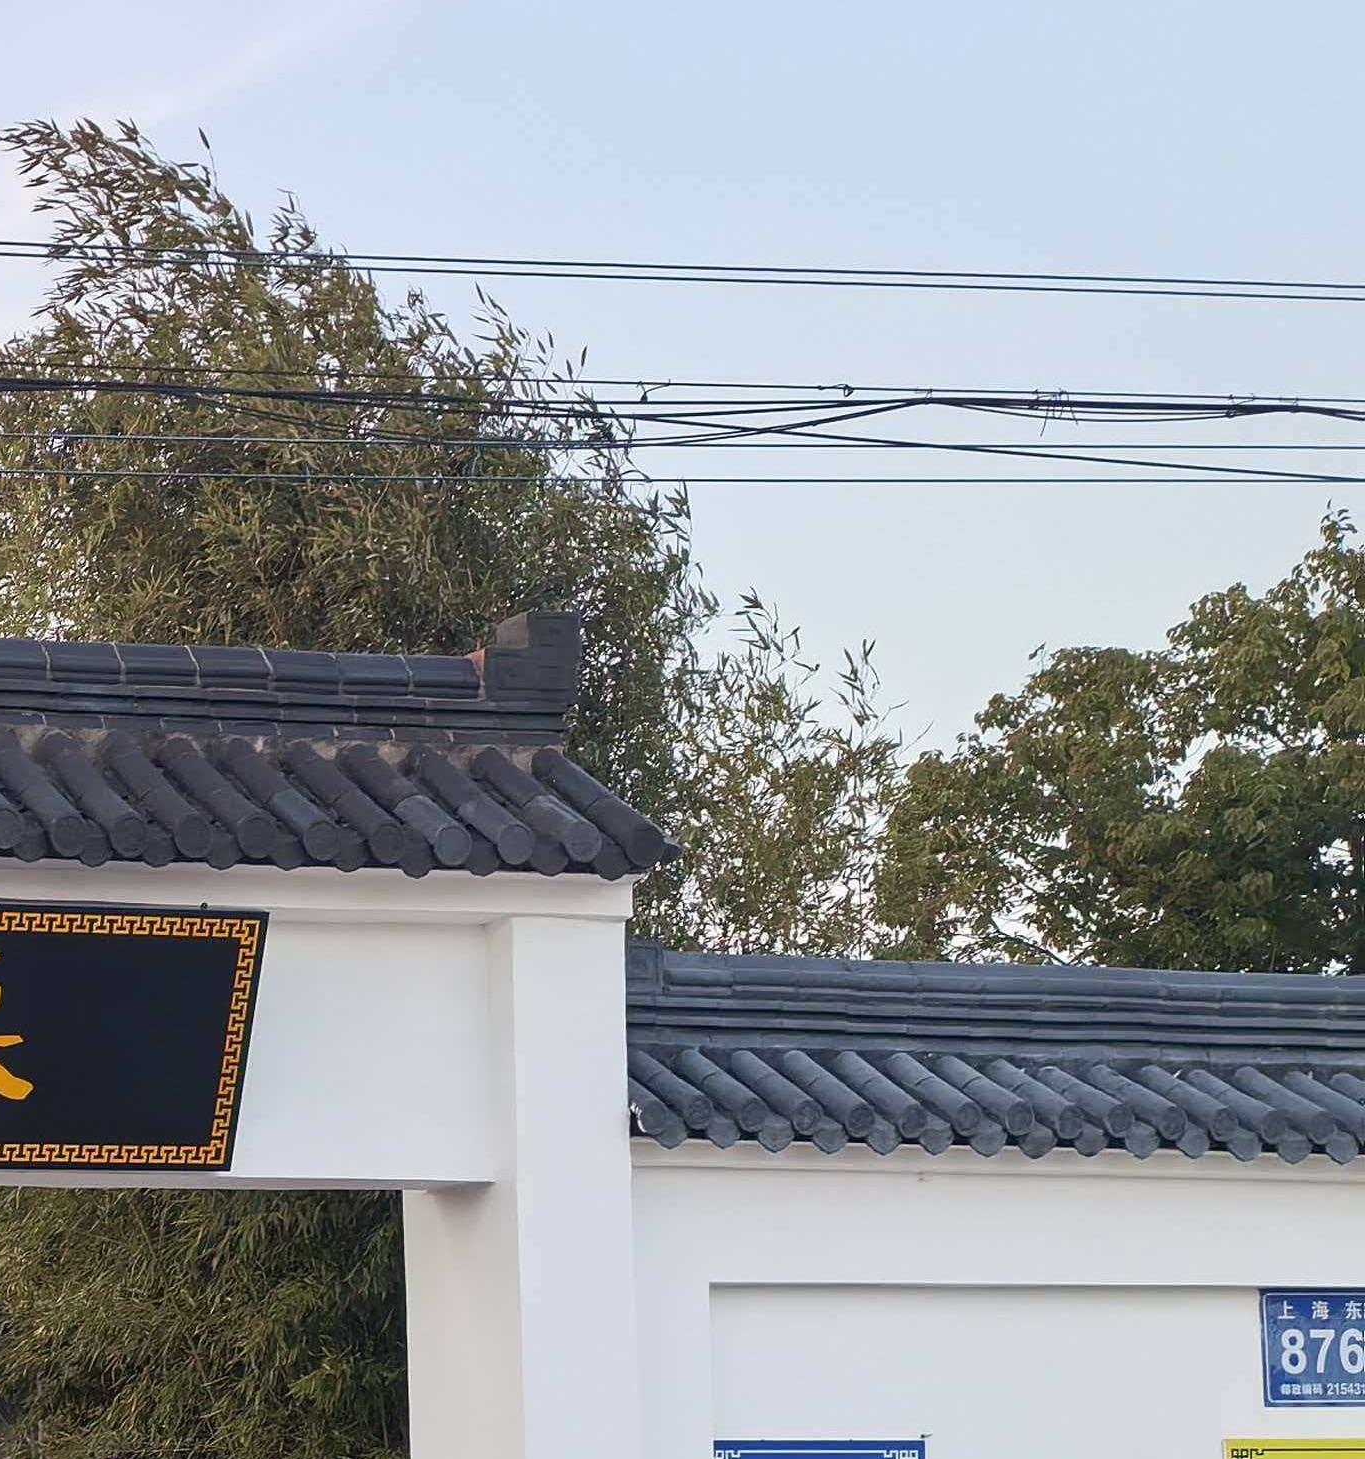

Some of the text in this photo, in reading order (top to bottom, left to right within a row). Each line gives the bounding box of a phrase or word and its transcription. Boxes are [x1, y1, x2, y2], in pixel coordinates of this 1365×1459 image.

[1277, 1300, 1365, 1320] 上海东
[1281, 1328, 1365, 1375] 876
